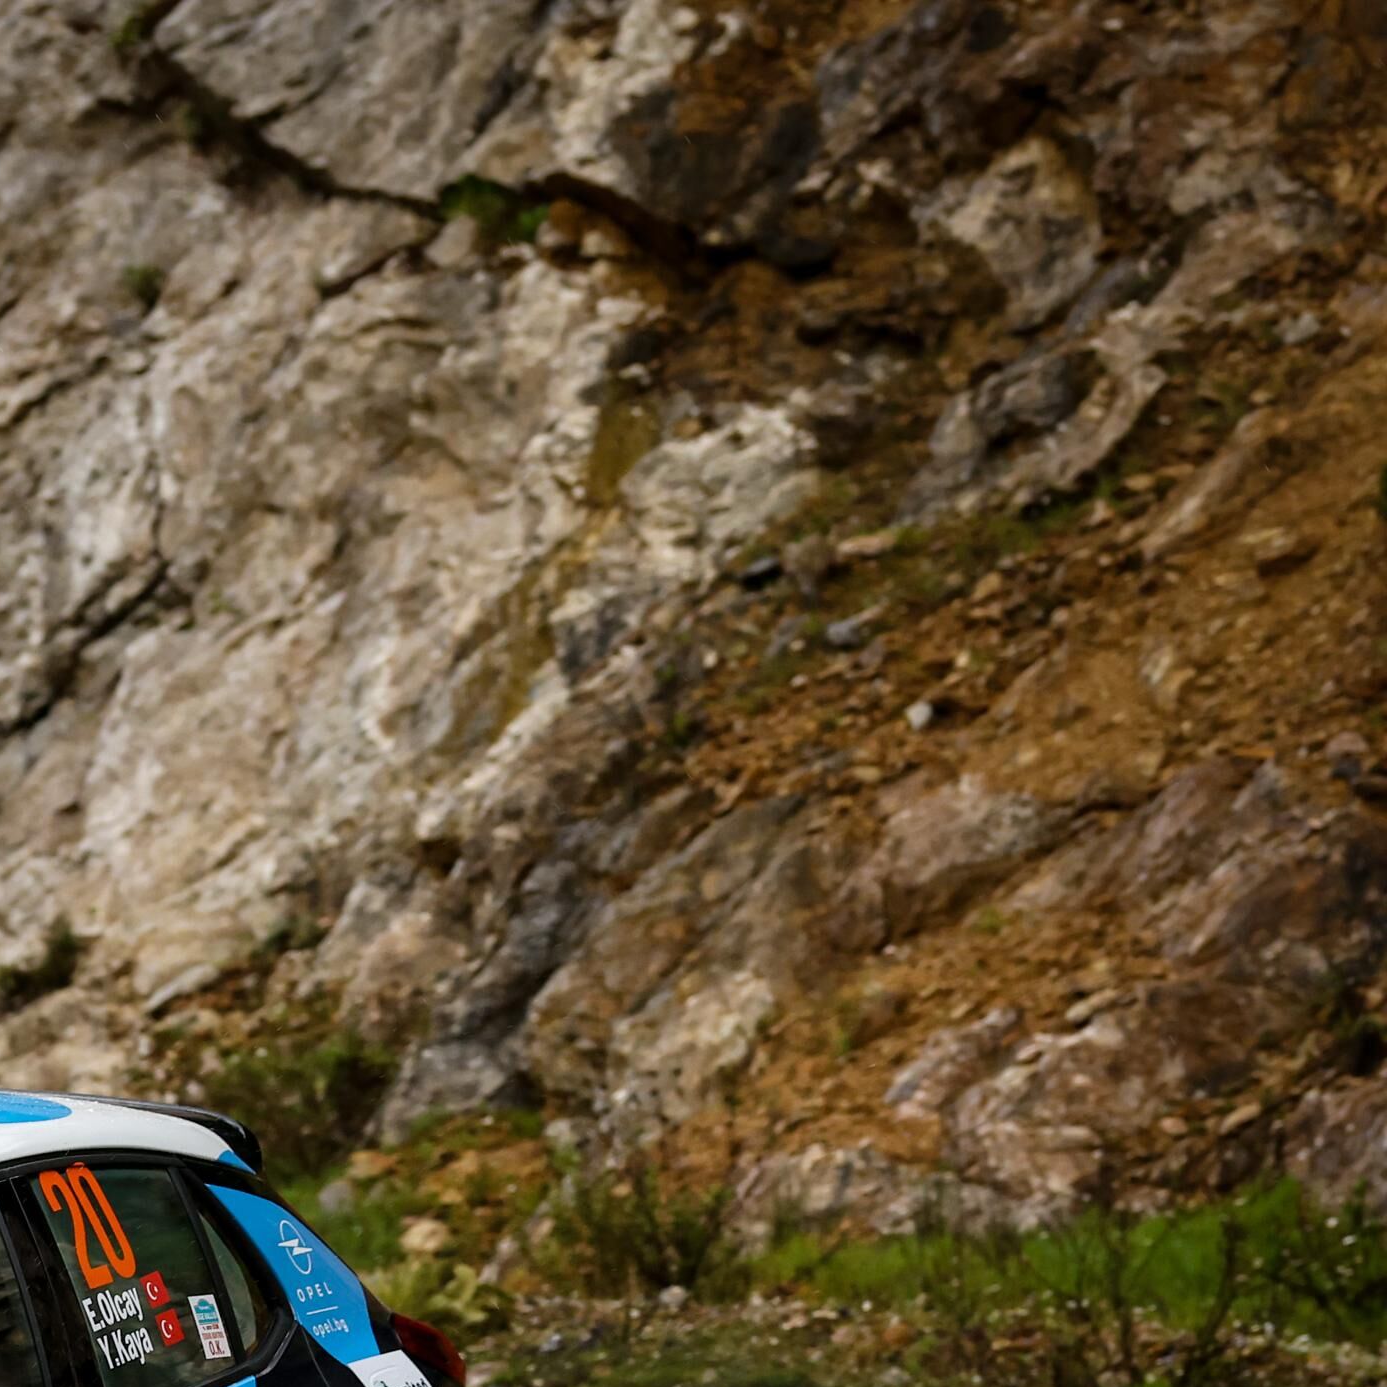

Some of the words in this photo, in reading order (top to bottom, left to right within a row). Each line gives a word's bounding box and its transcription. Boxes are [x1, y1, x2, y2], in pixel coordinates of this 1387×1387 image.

[38, 1162, 137, 1289] 20
[82, 1287, 143, 1332] E.Olcay
[296, 1281, 333, 1302] OPEL
[96, 1327, 154, 1369] Y.Kaya
[312, 1317, 349, 1338] opel.bg
